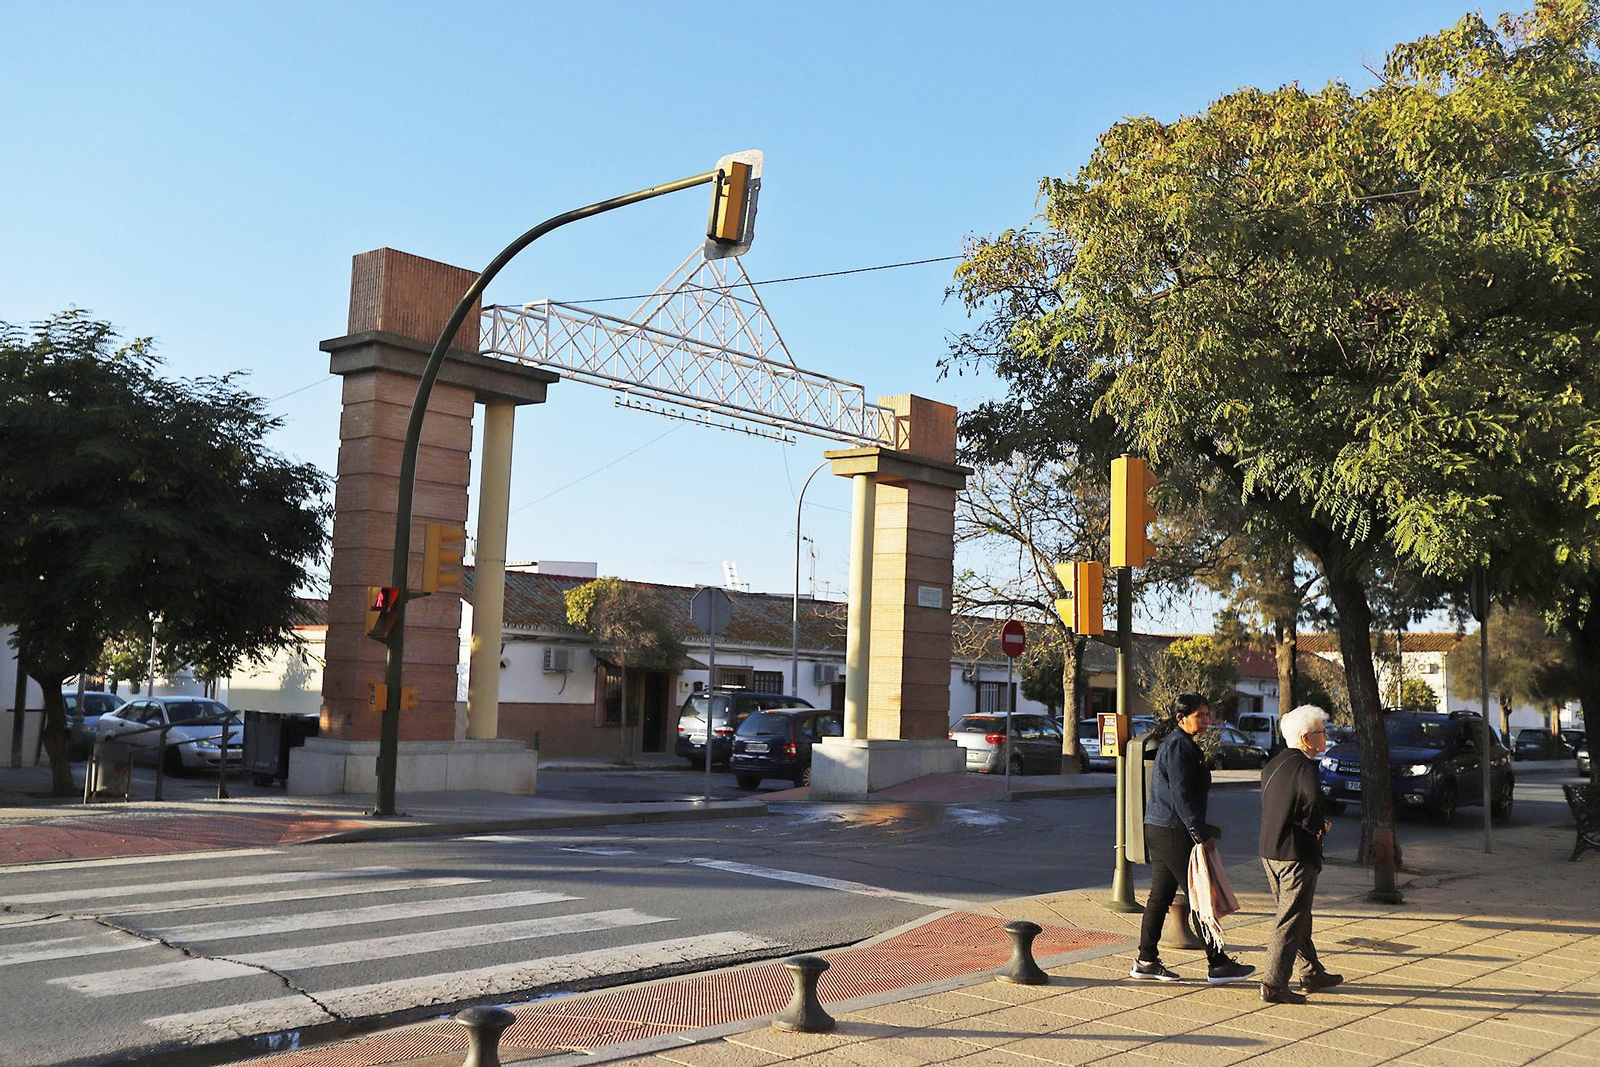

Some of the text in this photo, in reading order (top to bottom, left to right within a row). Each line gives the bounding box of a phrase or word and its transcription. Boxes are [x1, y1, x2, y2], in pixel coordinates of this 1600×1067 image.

[614, 395, 686, 421] BARRIADA
[695, 414, 711, 428] DE
[720, 419, 736, 432] LA
